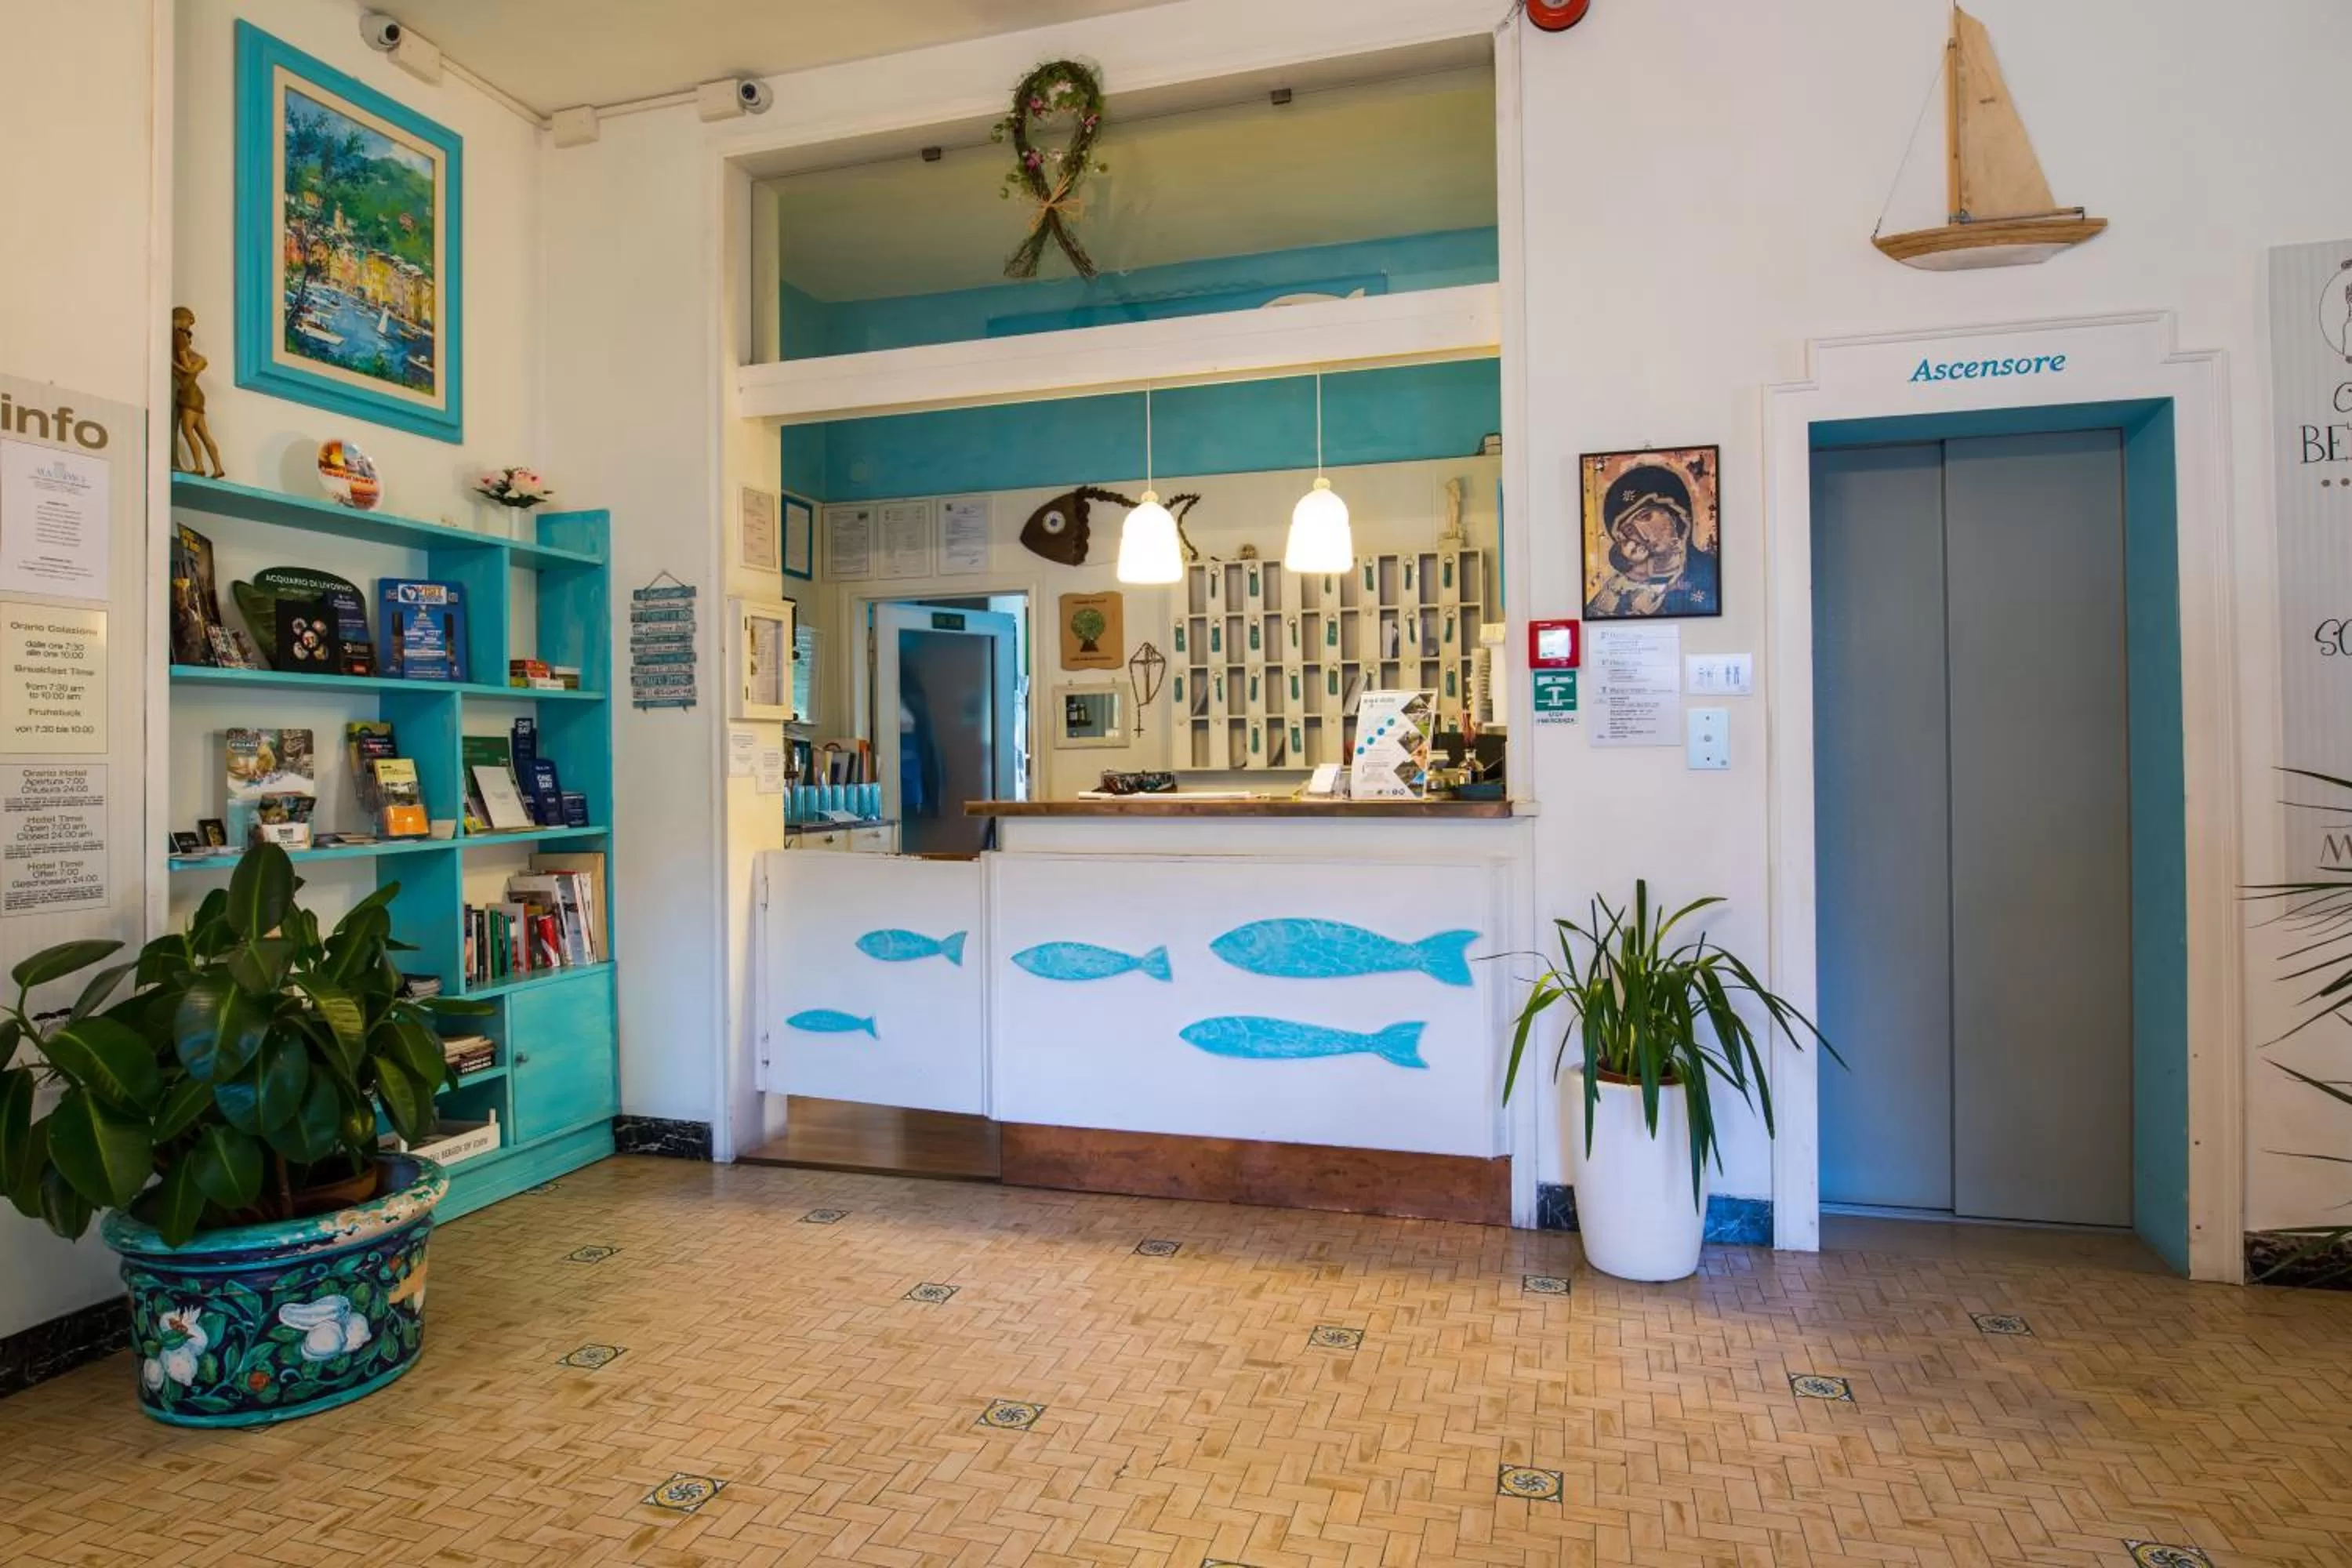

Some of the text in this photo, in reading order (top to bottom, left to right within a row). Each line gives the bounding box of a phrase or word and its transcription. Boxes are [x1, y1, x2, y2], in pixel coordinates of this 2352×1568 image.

[1908, 354, 2065, 382] Ascensore
[1, 393, 108, 449] info
[2299, 421, 2352, 464] BE
